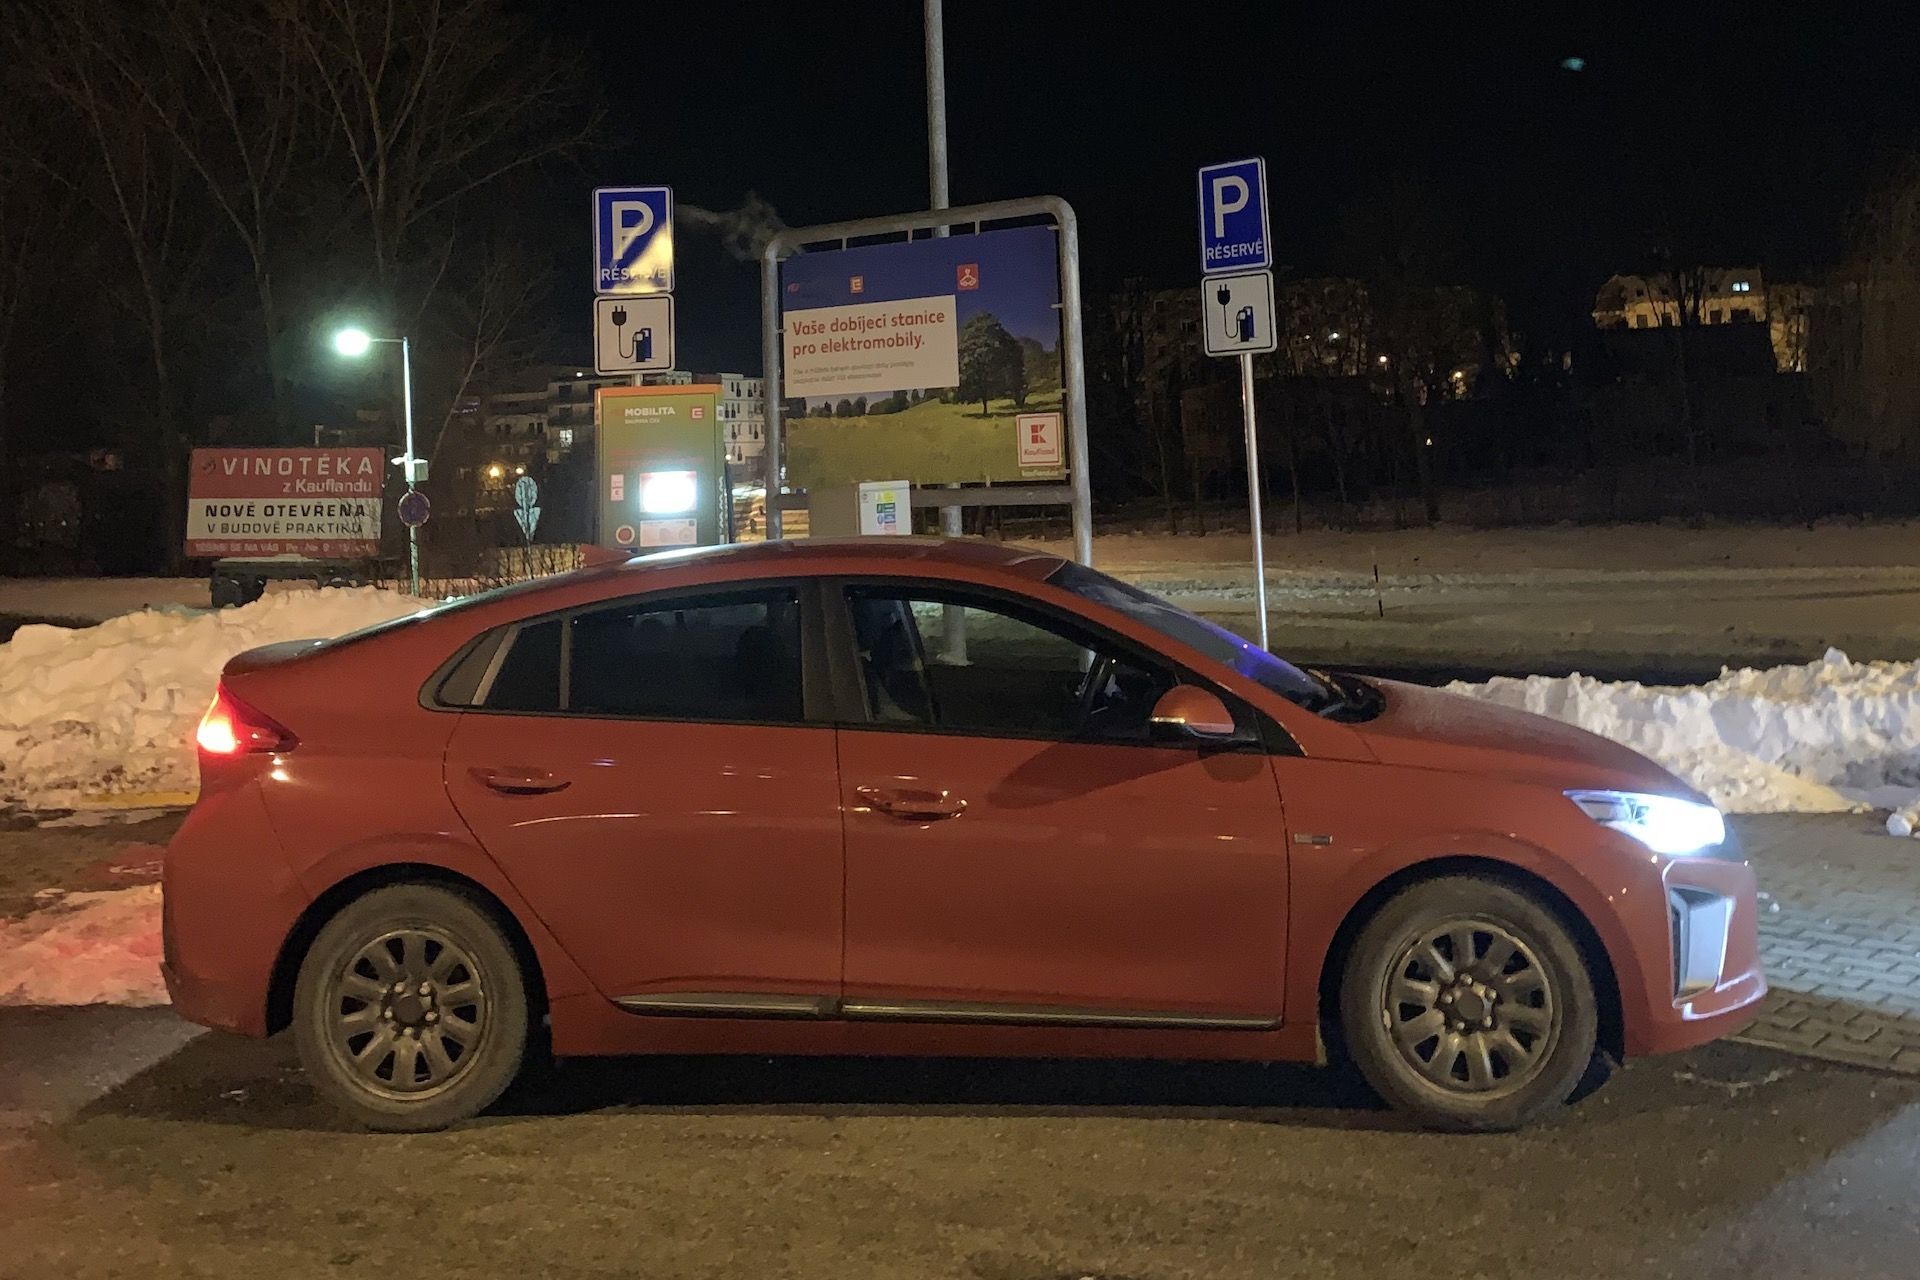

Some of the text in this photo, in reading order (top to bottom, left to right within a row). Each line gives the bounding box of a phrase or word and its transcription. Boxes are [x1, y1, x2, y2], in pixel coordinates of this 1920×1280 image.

[1213, 175, 1249, 238] P
[611, 200, 654, 260] P
[1206, 239, 1263, 260] RÉSERVÉ
[600, 264, 666, 281] RÉSVÉ
[792, 319, 826, 336] Vaše
[891, 310, 945, 328] stanice
[792, 331, 925, 359] pro elektromobily.
[624, 406, 676, 417] MOBILITA
[222, 453, 373, 476] VINOTÉKA
[282, 478, 372, 494] z Kauflandu
[205, 501, 366, 518] NOVĚ OTEVŘENA
[207, 523, 215, 534] V
[221, 521, 280, 534] BUDOVĚ
